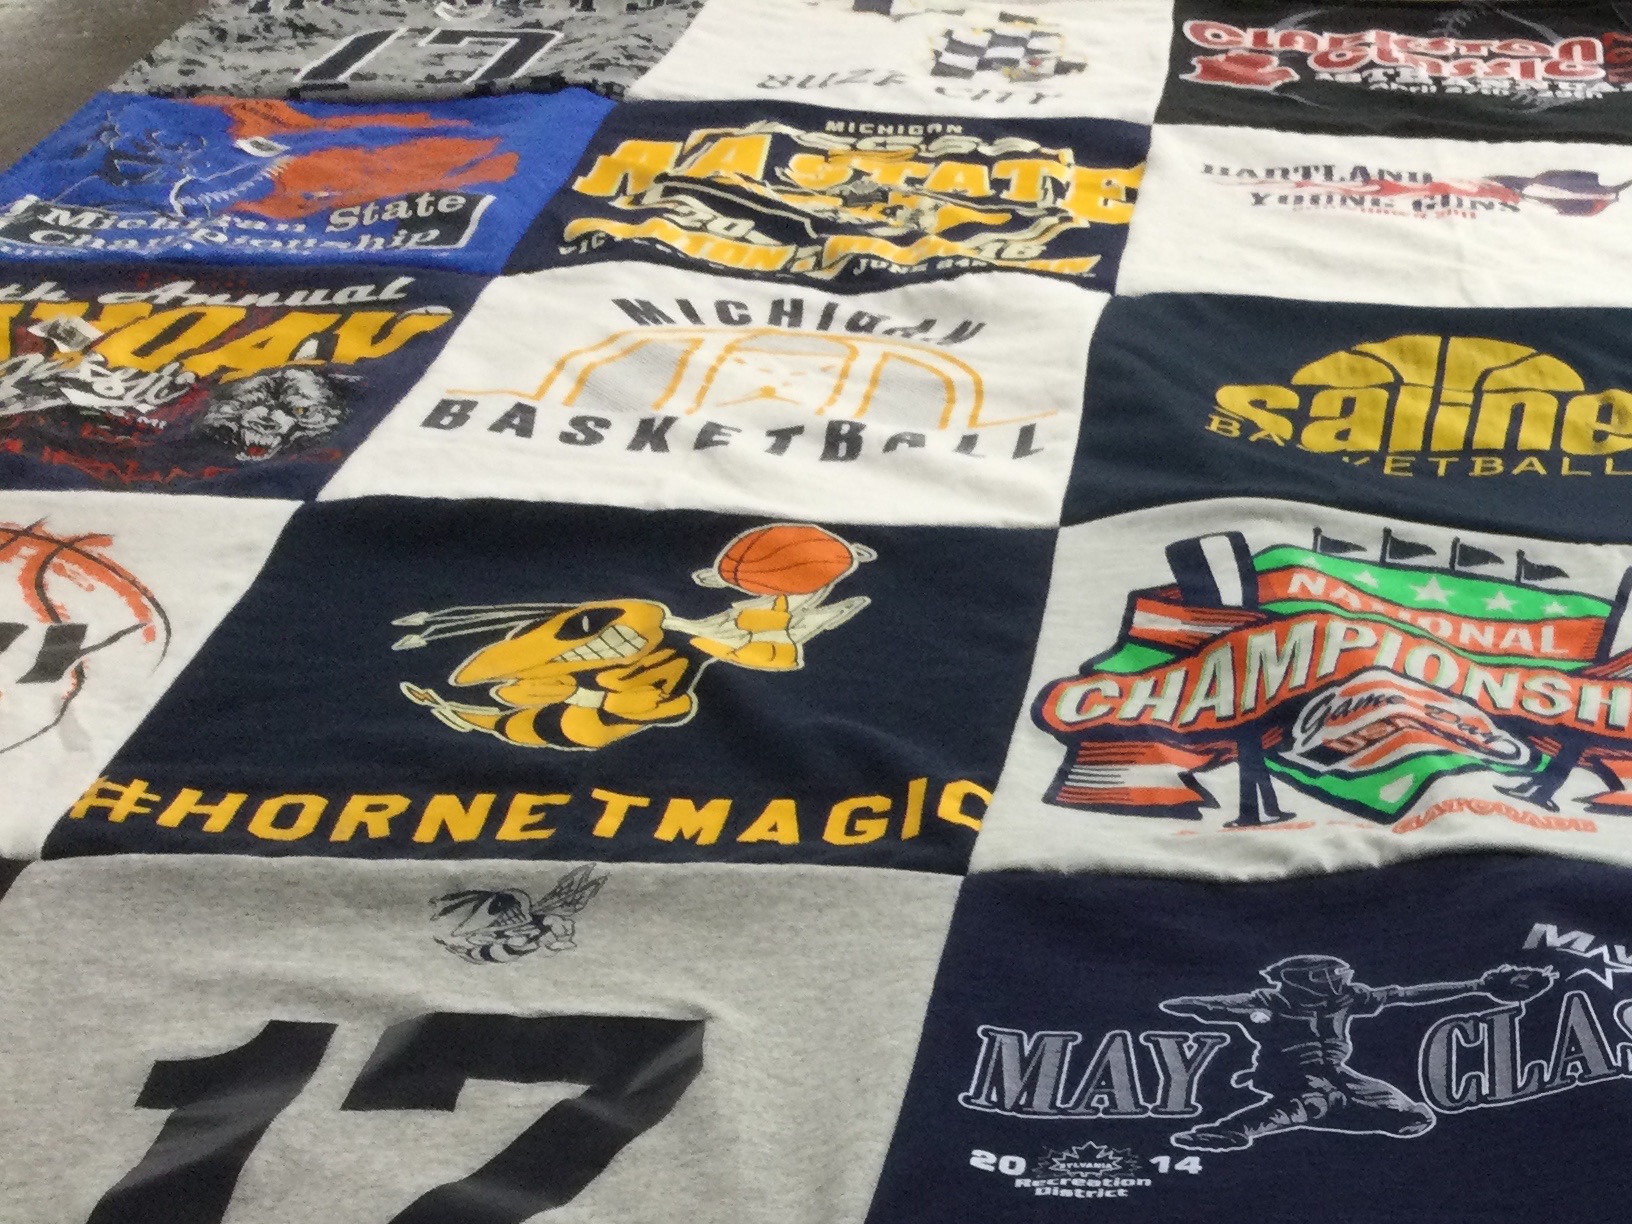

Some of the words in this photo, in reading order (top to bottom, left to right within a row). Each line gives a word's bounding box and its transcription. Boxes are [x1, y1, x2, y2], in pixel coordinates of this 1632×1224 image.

[293, 27, 565, 84] 17
[825, 120, 963, 134] MICHIGAN
[326, 190, 468, 232] State
[785, 152, 1146, 225] STATE
[97, 276, 416, 307] Annual
[611, 298, 986, 346] MICHIGAN
[420, 397, 1047, 463] BASKETBALL
[1287, 571, 1570, 656] NATIONAL
[1299, 692, 1406, 747] Game
[1424, 703, 1522, 762] Day
[68, 775, 999, 848] #HORNETMAGIC
[959, 1023, 1230, 1119] MAY
[969, 1149, 1027, 1176] 20
[1149, 1155, 1203, 1175] 14
[1014, 1177, 1152, 1189] Recreation
[1058, 1161, 1113, 1170] SYLVANIA
[1034, 1187, 1129, 1199] District
